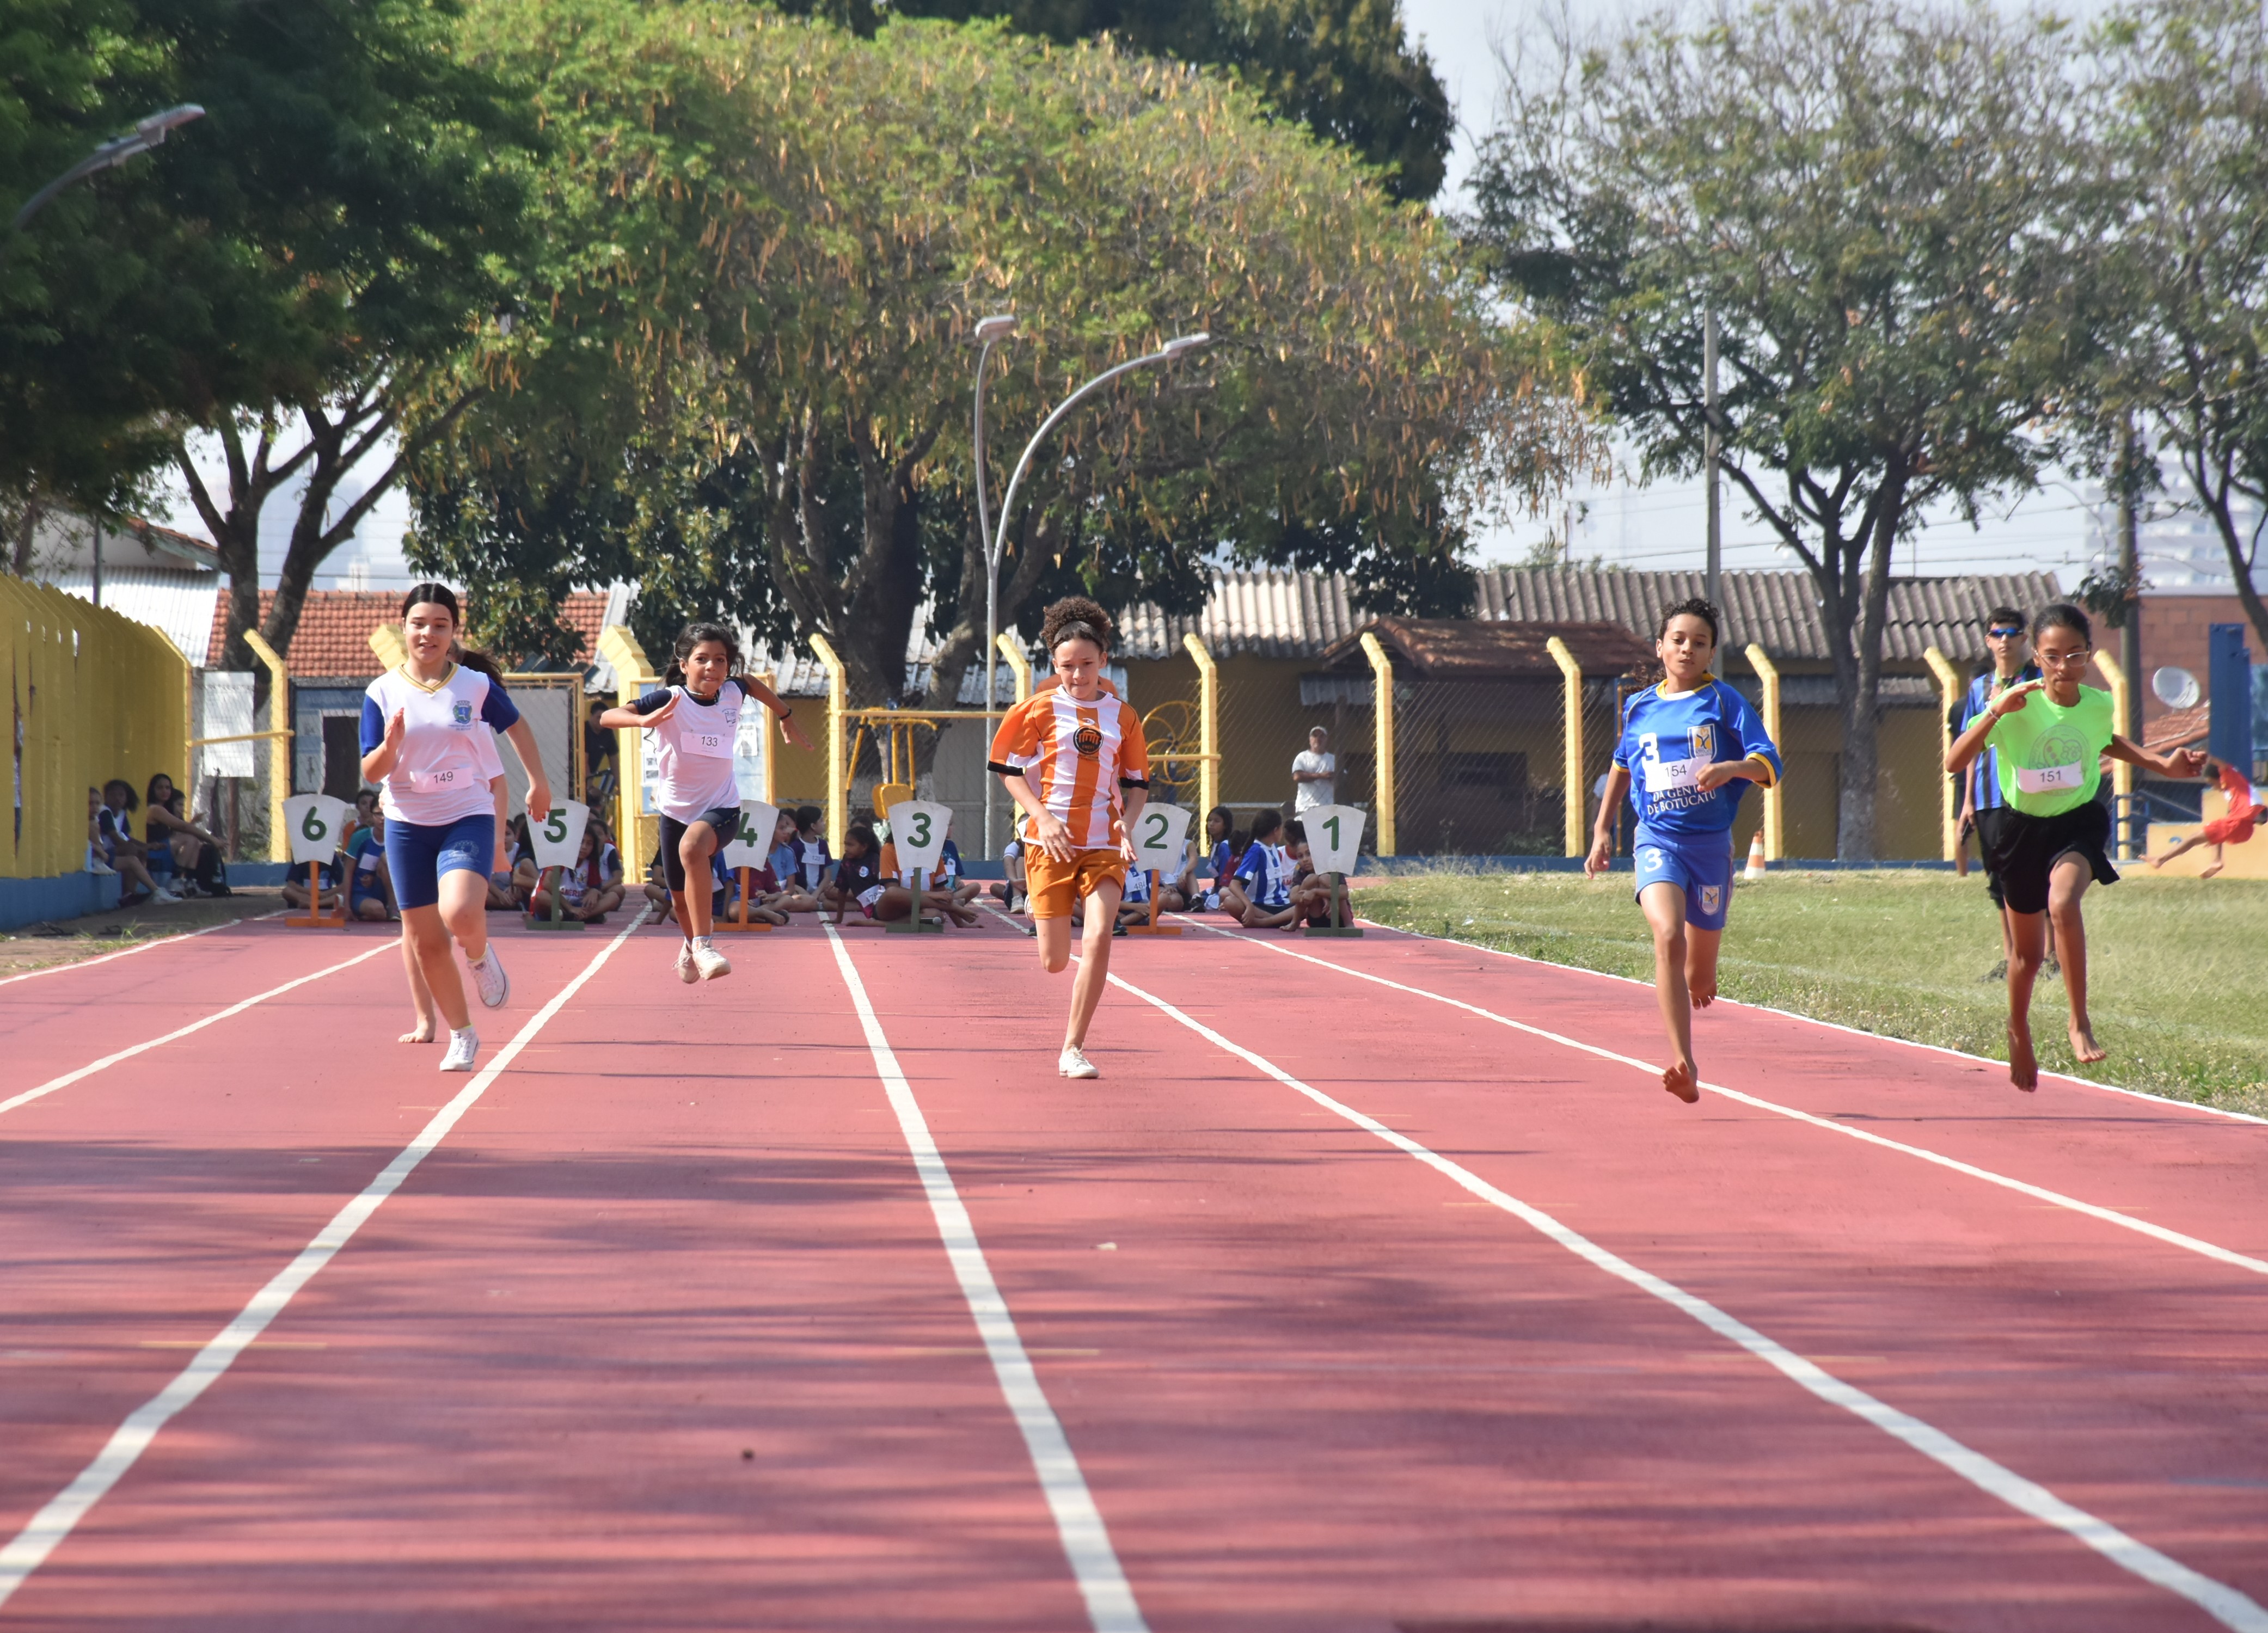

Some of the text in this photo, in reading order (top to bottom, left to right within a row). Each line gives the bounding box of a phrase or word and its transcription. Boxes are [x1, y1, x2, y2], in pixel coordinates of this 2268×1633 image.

[701, 735, 718, 747] 133
[1639, 732, 1659, 768] 3
[433, 771, 453, 784] 149
[1665, 764, 1687, 777] 154
[2040, 770, 2061, 783] 151
[1647, 789, 1717, 815] DE BOTUCATU
[1653, 784, 1700, 802] DA GENT
[302, 806, 327, 842] 6
[543, 808, 567, 843] 5
[733, 812, 758, 848] 4
[907, 812, 931, 848] 3
[1143, 813, 1169, 849] 2
[1322, 815, 1339, 851] 1
[1644, 848, 1663, 873] 3
